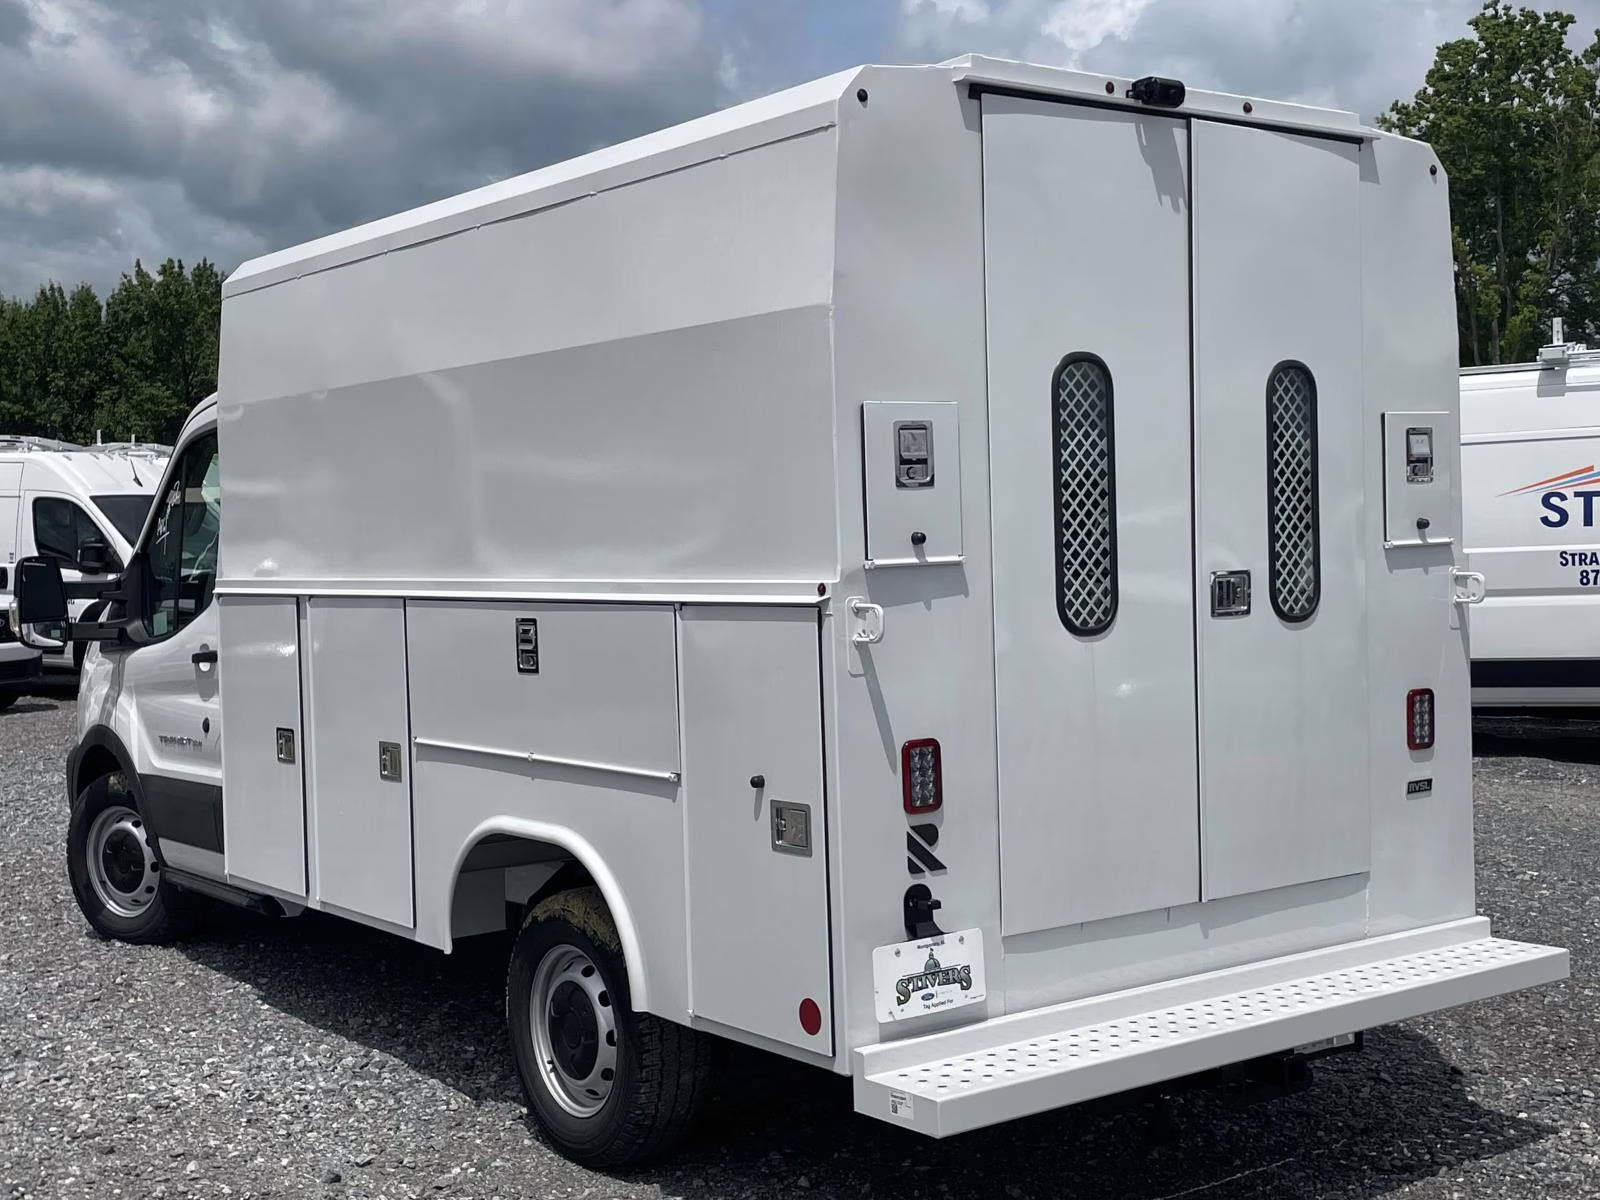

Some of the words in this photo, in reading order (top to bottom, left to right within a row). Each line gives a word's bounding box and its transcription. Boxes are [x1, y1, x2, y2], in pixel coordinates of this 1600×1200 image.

[1540, 491, 1600, 528] ST
[1579, 570, 1600, 586] 87
[896, 965, 972, 1006] STIVERS
